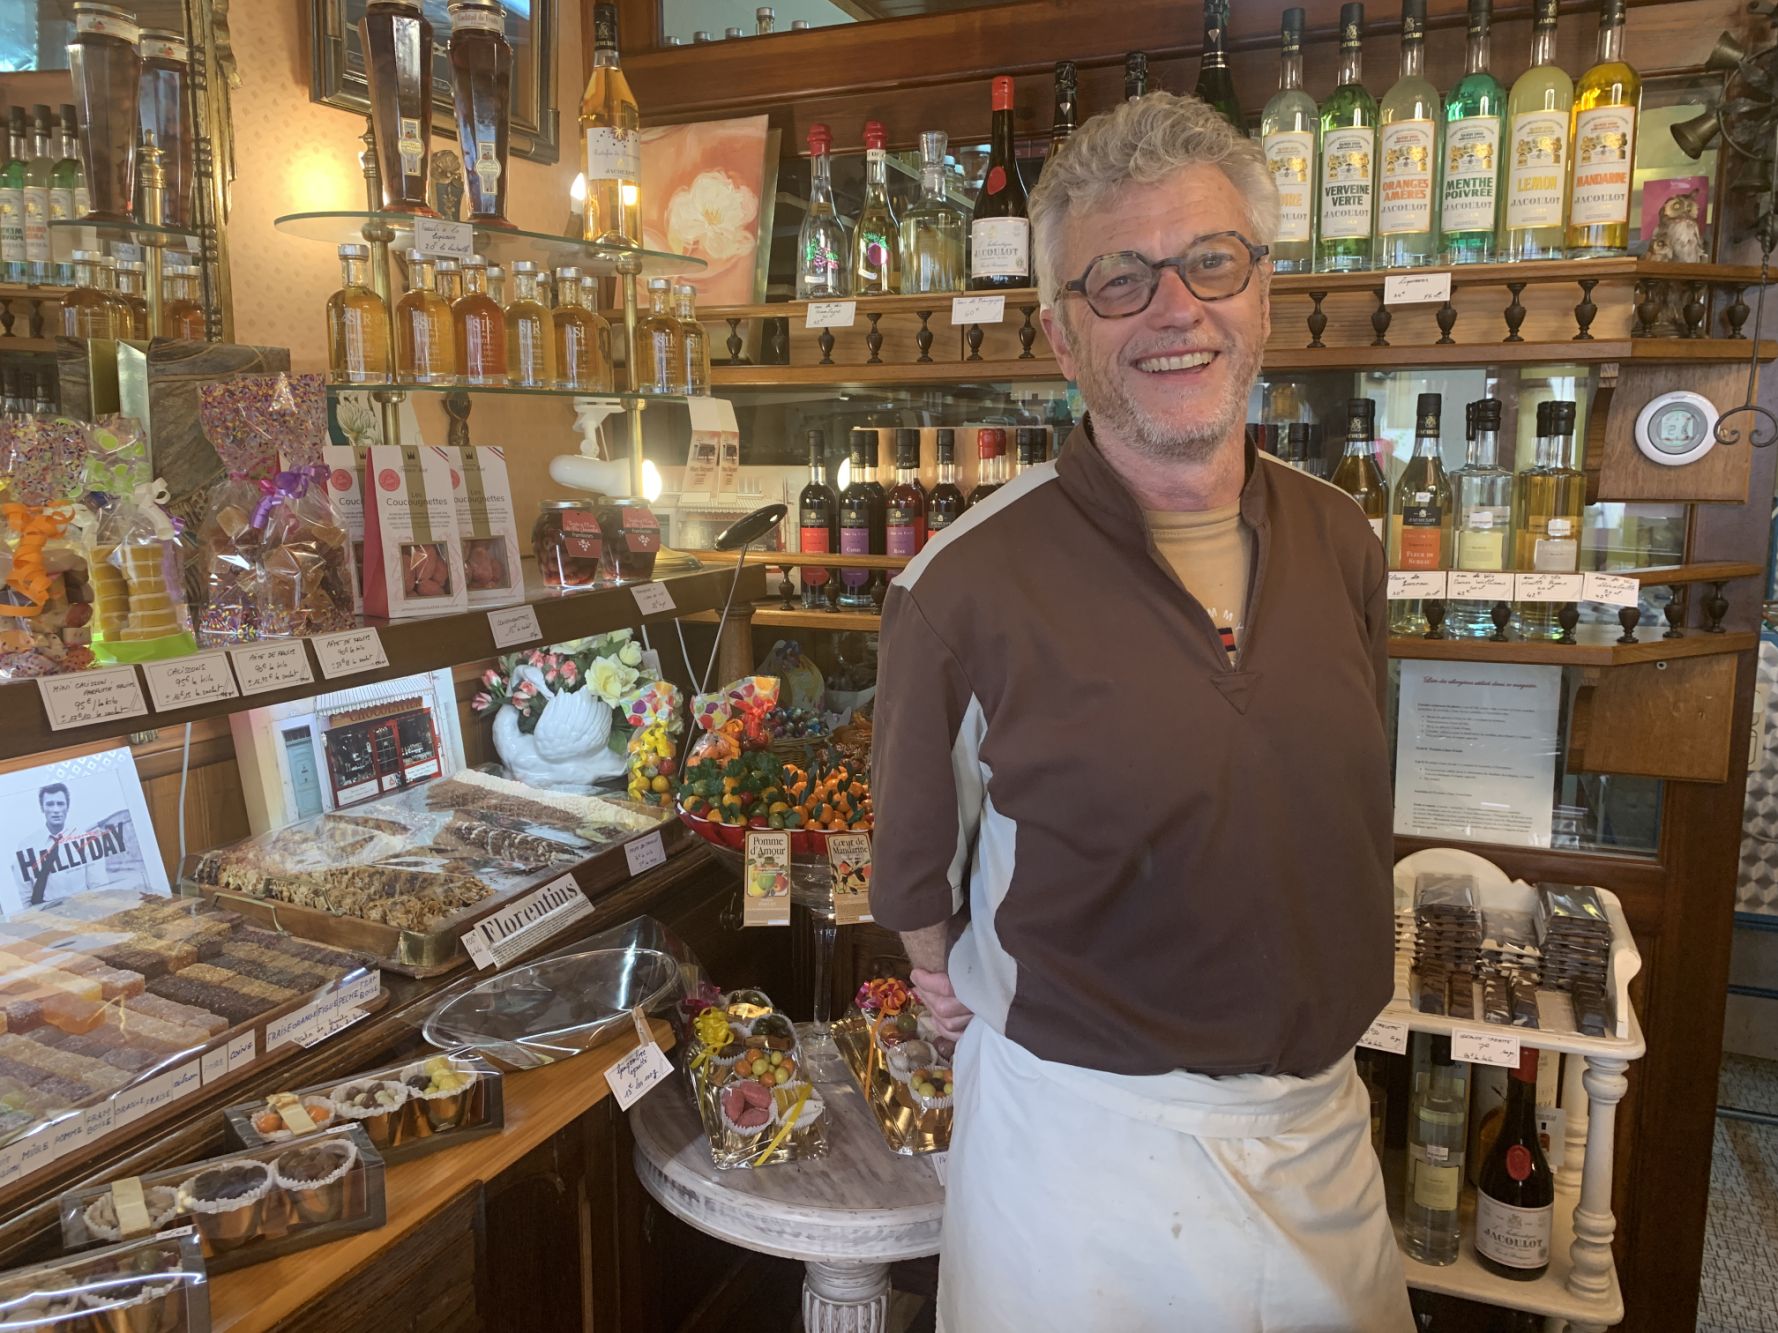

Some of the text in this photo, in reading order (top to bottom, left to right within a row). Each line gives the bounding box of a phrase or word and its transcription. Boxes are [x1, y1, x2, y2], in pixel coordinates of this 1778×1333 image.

[1382, 178, 1429, 192] ORANGES
[1445, 177, 1494, 191] MENTHE
[1325, 184, 1370, 196] VERVEINE
[1445, 188, 1493, 200] POIVRÉE
[1332, 196, 1363, 206] VERTE
[1511, 197, 1560, 207] JACOULOT
[1574, 194, 1625, 204] JACOULOT
[1381, 204, 1428, 213] JACOULOT
[1444, 202, 1493, 211] JACOULOT
[1324, 210, 1369, 218] JACOULOT
[386, 497, 448, 508] Coucougnettes
[454, 494, 505, 504] oucougnettes
[753, 836, 784, 846] Pomme
[855, 838, 864, 846] de
[16, 822, 126, 882] HALLYDAY
[750, 846, 786, 856] d'Amour
[480, 882, 578, 943] Florentins
[268, 1021, 292, 1044] FRAISE
[1484, 1228, 1542, 1248] JACOULOT
